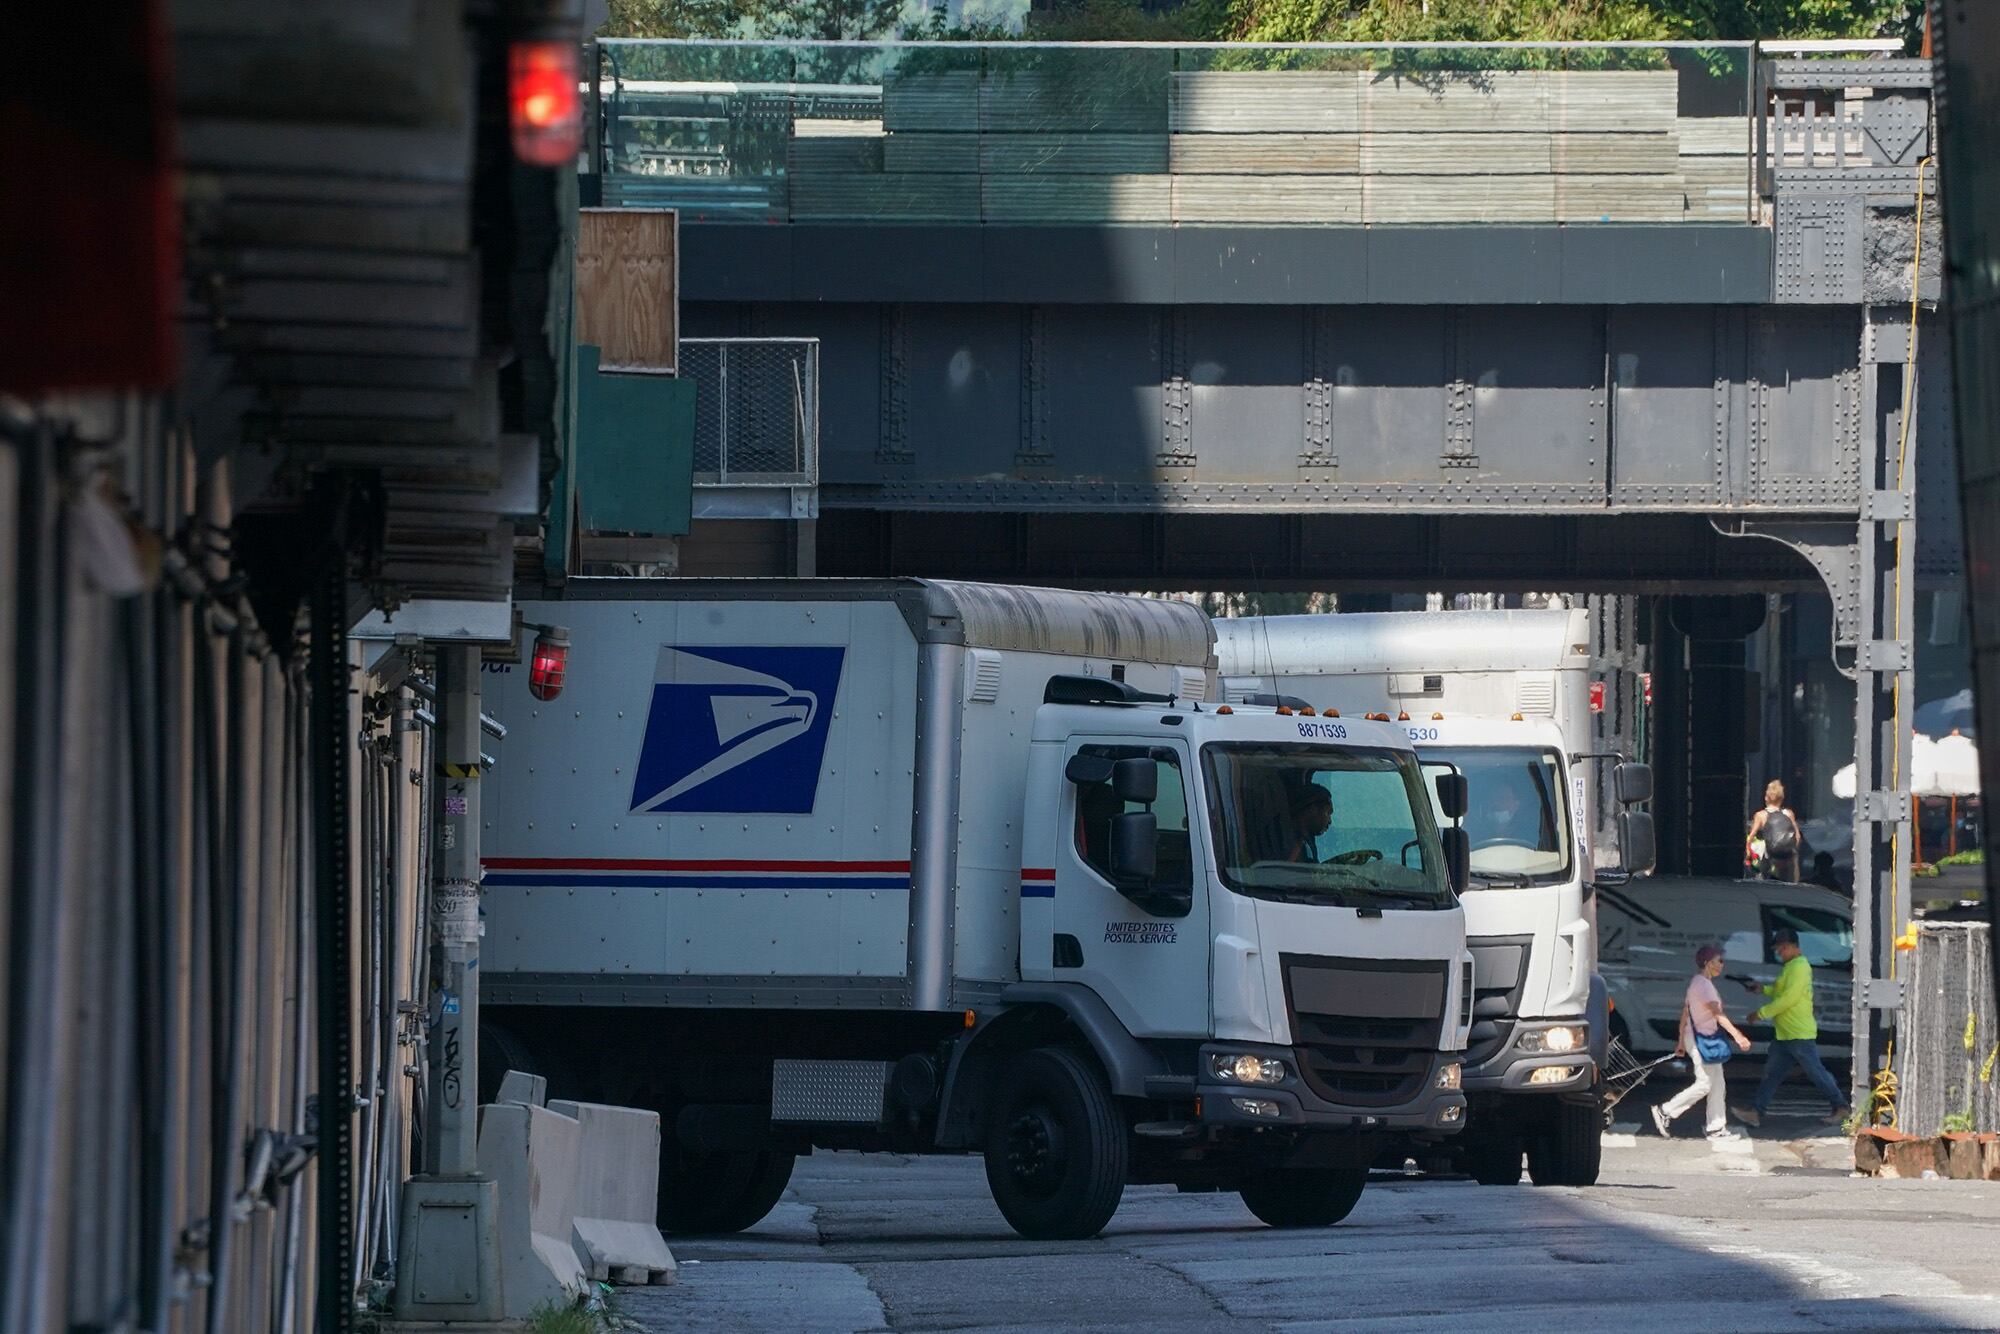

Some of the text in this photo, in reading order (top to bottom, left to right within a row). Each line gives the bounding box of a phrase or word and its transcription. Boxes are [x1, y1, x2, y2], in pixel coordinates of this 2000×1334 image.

[1298, 722, 1347, 739] 8871539
[1403, 728, 1438, 740] 530
[1106, 922, 1175, 932] UNITED STATES
[1104, 933, 1177, 943] POSTAL SERVICE
